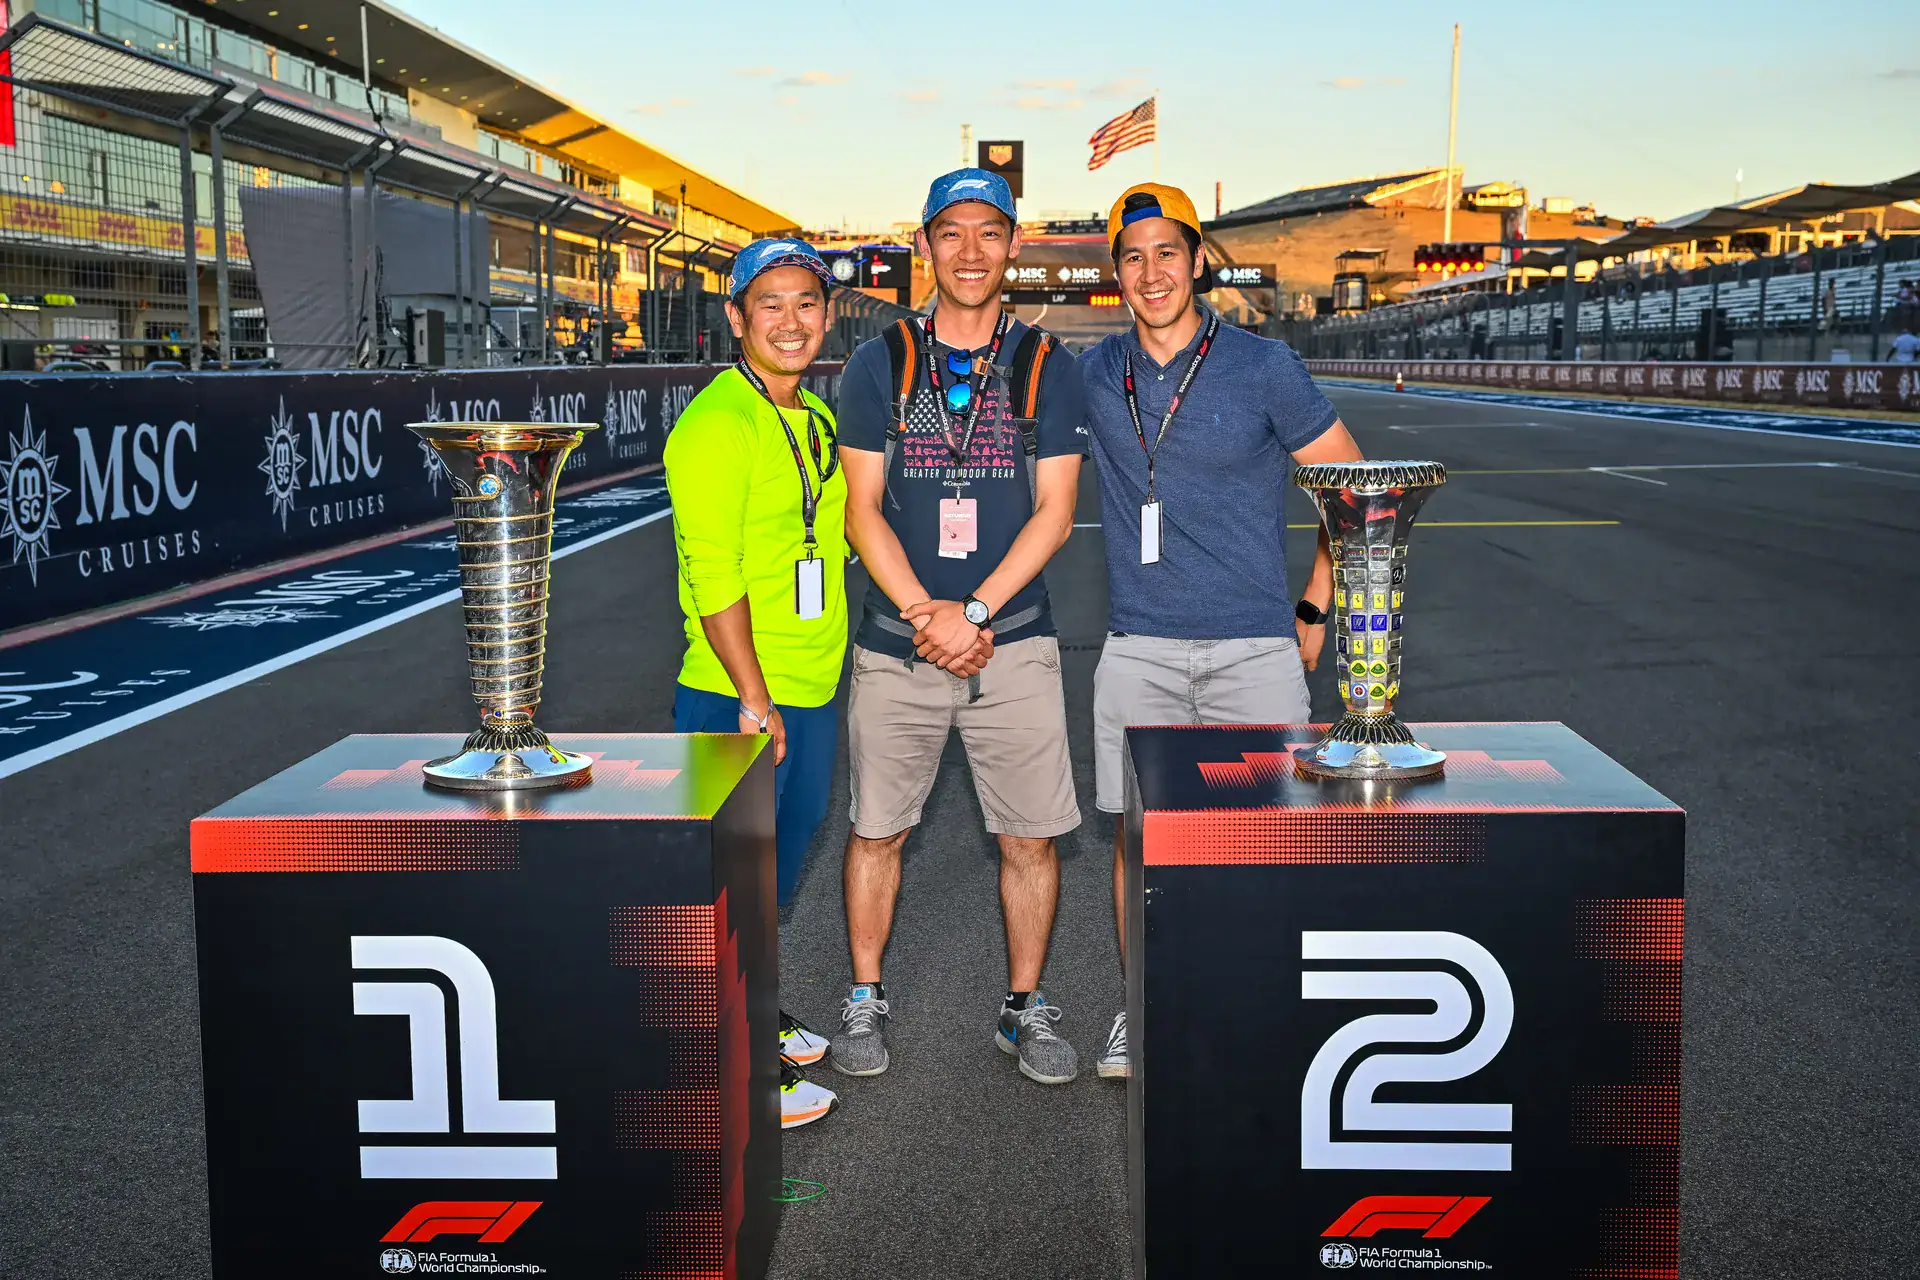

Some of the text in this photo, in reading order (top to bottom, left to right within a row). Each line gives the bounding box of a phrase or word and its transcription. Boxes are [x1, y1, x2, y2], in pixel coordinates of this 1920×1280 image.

[1019, 268, 1047, 279] MSC
[1071, 268, 1099, 279] MSC
[1233, 268, 1261, 279] MSC
[1052, 294, 1067, 303] LAP
[1178, 355, 1202, 393] Experiences
[1805, 370, 1830, 392] MSC
[1856, 370, 1883, 393] MSC
[619, 388, 647, 434] MSC
[307, 408, 383, 487] MSC
[73, 420, 198, 525] MSC
[903, 468, 1015, 479] GREATER OUDOOR GEAR
[309, 493, 385, 527] CRUISES
[78, 530, 200, 578] CRUISES
[214, 570, 415, 606] MSC
[0, 669, 191, 735] RUISES
[350, 935, 558, 1179] 1
[1301, 930, 1514, 1171] 2
[417, 1252, 498, 1263] FIA Formula 1
[1359, 1247, 1442, 1258] FIA Formula 1
[1360, 1258, 1395, 1269] World
[418, 1263, 455, 1273] World
